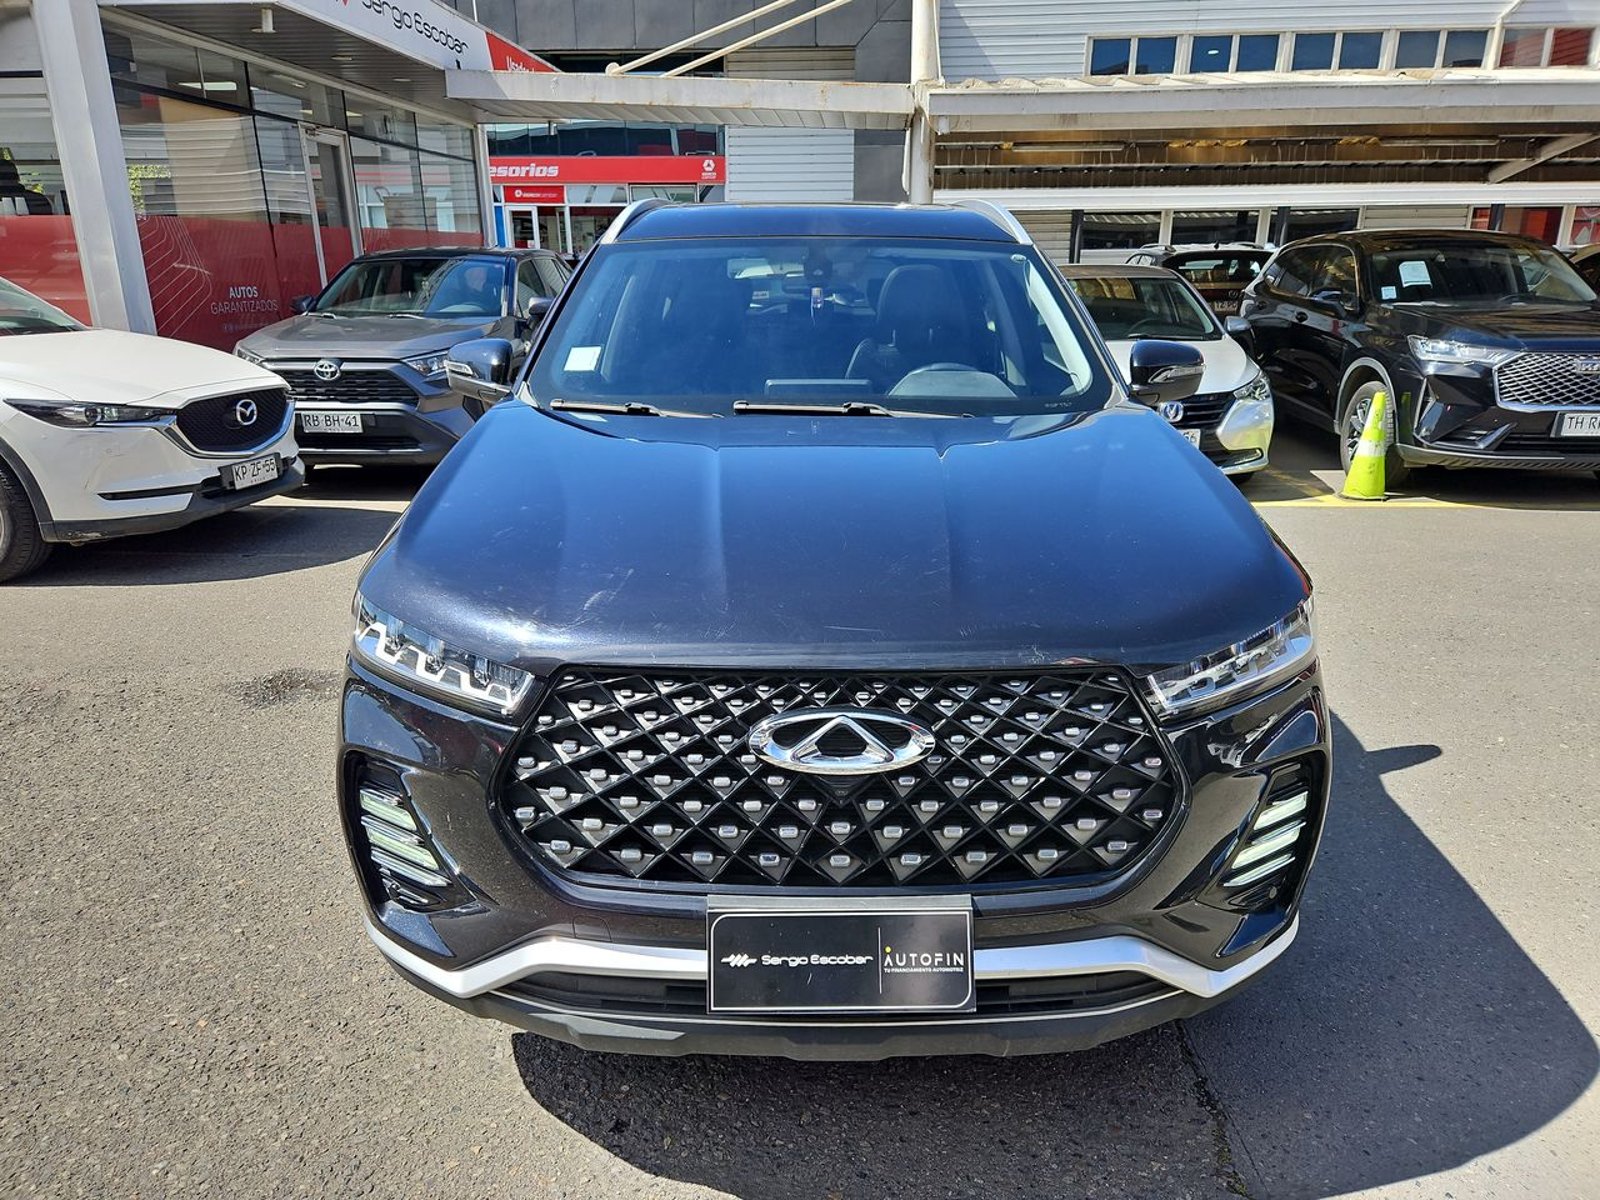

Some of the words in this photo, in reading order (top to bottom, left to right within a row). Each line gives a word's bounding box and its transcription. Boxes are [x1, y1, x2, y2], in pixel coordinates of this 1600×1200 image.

[413, 12, 469, 55] Escobar
[229, 286, 258, 299] AUTOS
[210, 300, 279, 315] GARANTIZADOS
[761, 955, 809, 967] Sergo
[810, 954, 873, 965] Escobar
[883, 952, 965, 967] AUTOFIN
